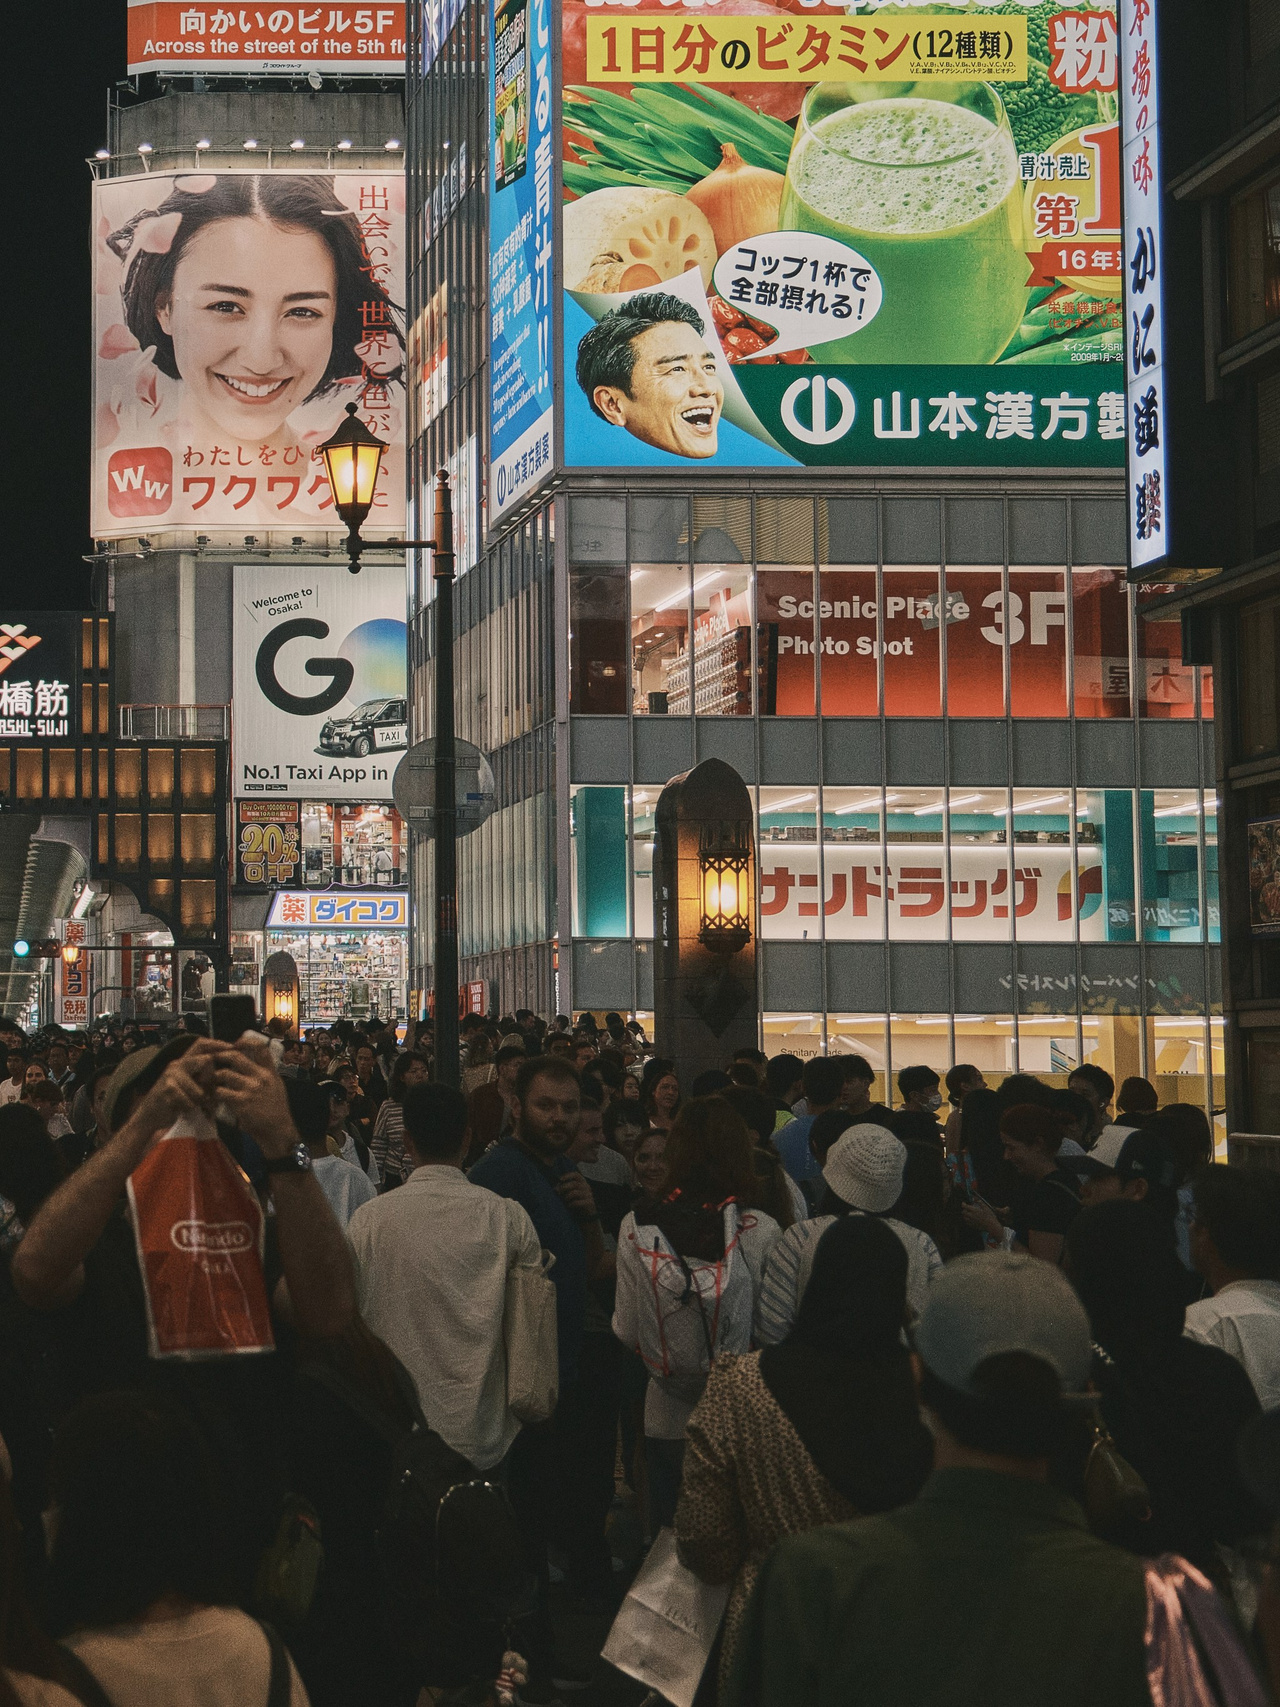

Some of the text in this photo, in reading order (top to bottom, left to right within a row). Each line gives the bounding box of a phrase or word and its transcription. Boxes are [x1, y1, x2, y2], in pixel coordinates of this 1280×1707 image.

[180, 8, 396, 35] 向かいのビル5F
[143, 39, 206, 56] Across
[210, 39, 240, 54] the
[244, 39, 297, 54] street
[300, 38, 318, 54] of
[323, 38, 354, 54] the
[356, 39, 385, 54] 5th
[1020, 154, 1091, 179] 青汁売上
[735, 247, 872, 292] コップ1杯で
[729, 276, 865, 321] 全部摂れる!
[252, 587, 313, 610] Welcome to
[268, 601, 303, 616] Osaka!
[778, 591, 1065, 646] Scenic Place 3F
[778, 636, 914, 659] Photo Spot
[380, 732, 401, 742] TAXI
[243, 764, 388, 783] No.1 Taxi App in
[241, 824, 299, 864] 20%
[760, 866, 1042, 918] サンドラッグ
[281, 894, 401, 923] 薬 ダイコク
[64, 999, 86, 1015] 免税
